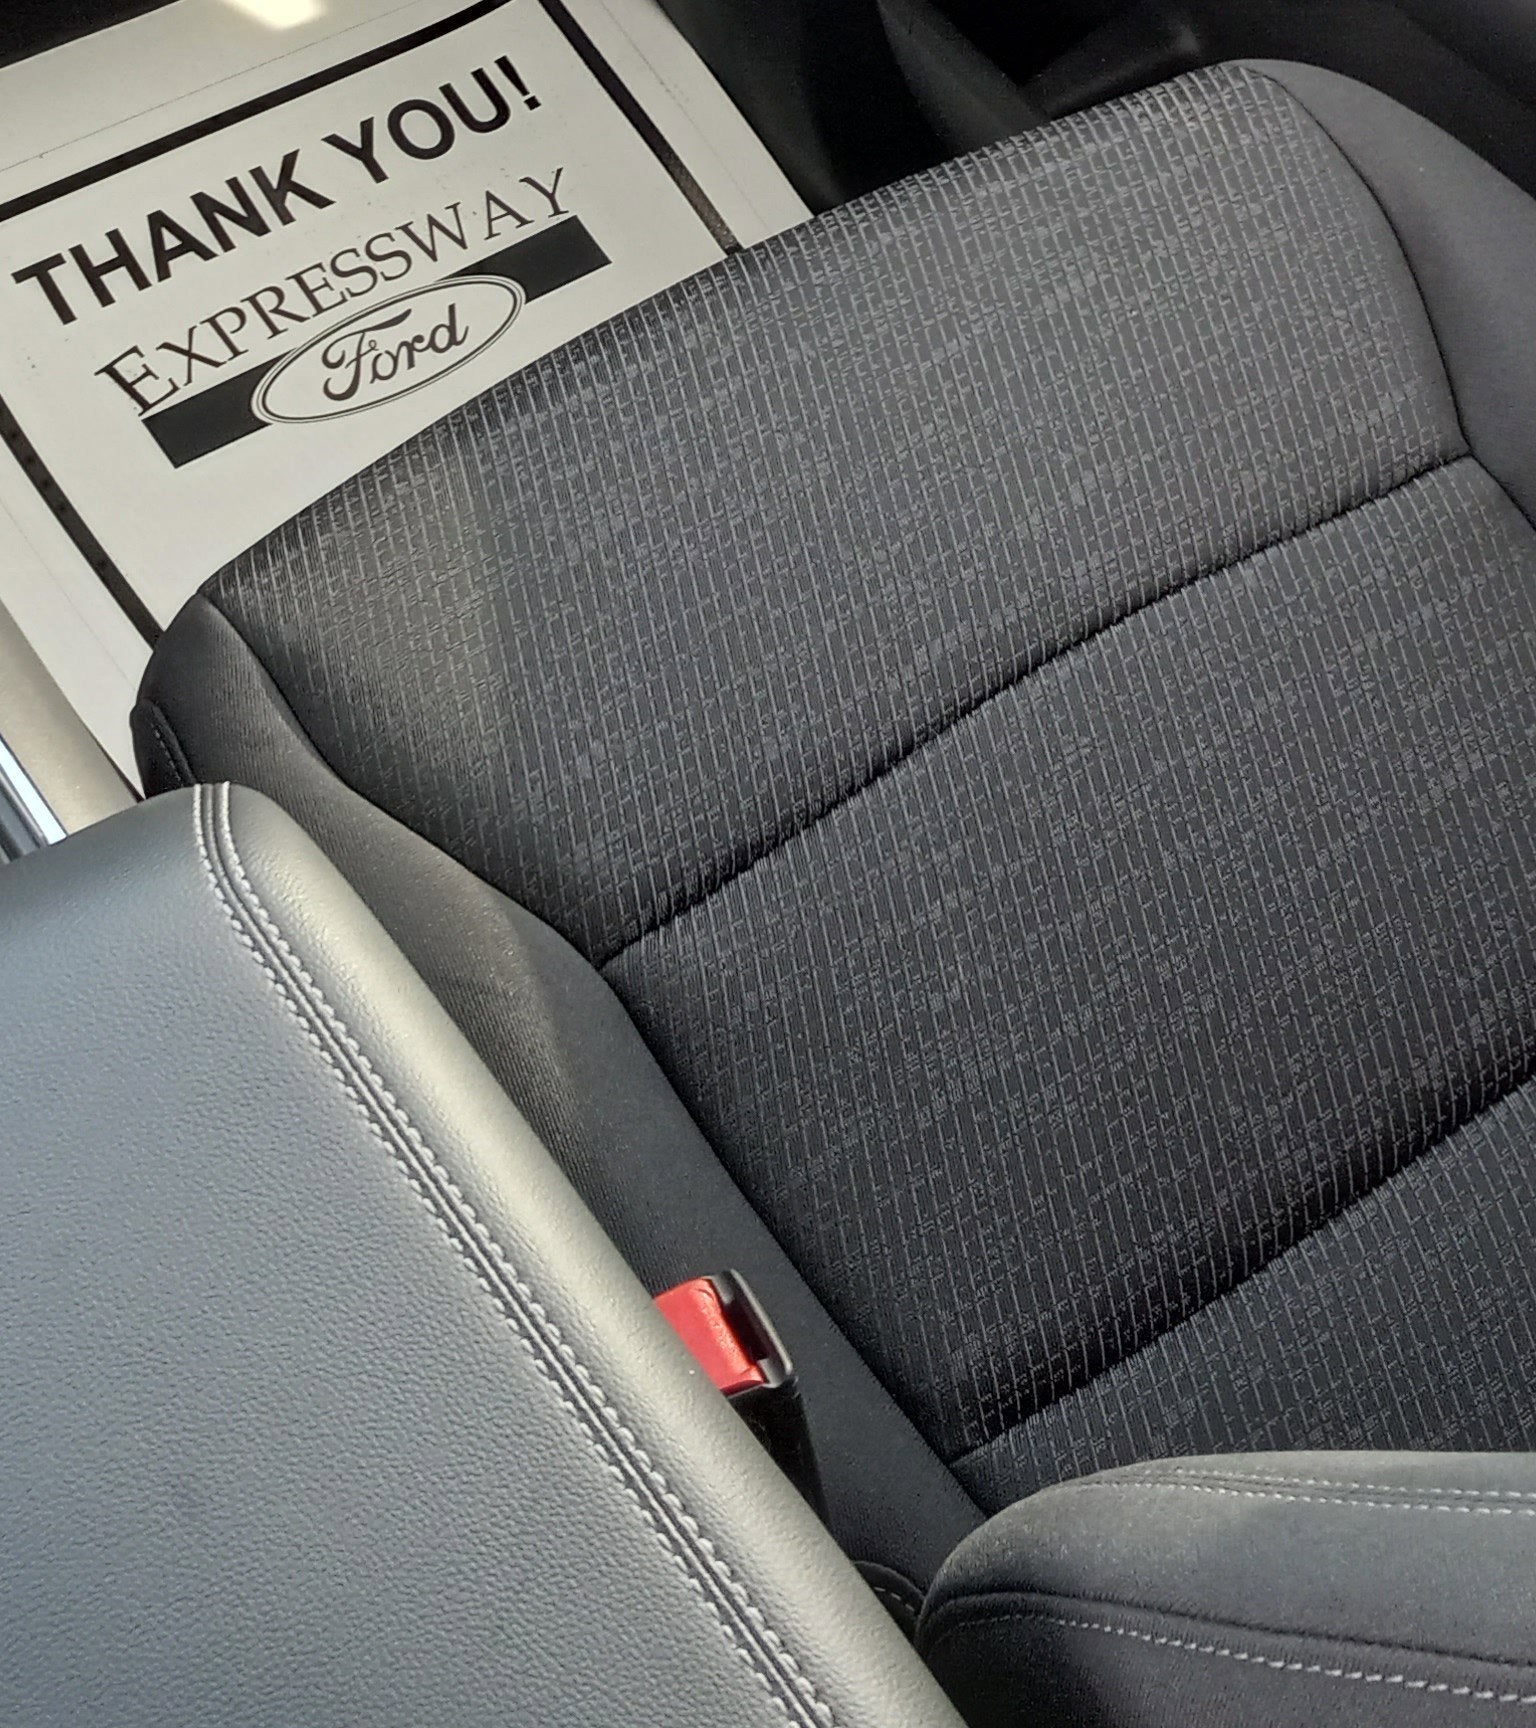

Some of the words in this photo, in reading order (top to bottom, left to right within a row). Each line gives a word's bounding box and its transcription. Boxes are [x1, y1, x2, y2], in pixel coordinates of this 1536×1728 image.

[12, 148, 335, 326] THANK
[322, 55, 543, 184] YOU!
[94, 166, 573, 418] EXPRESSWAY
[321, 301, 470, 404] Ford
